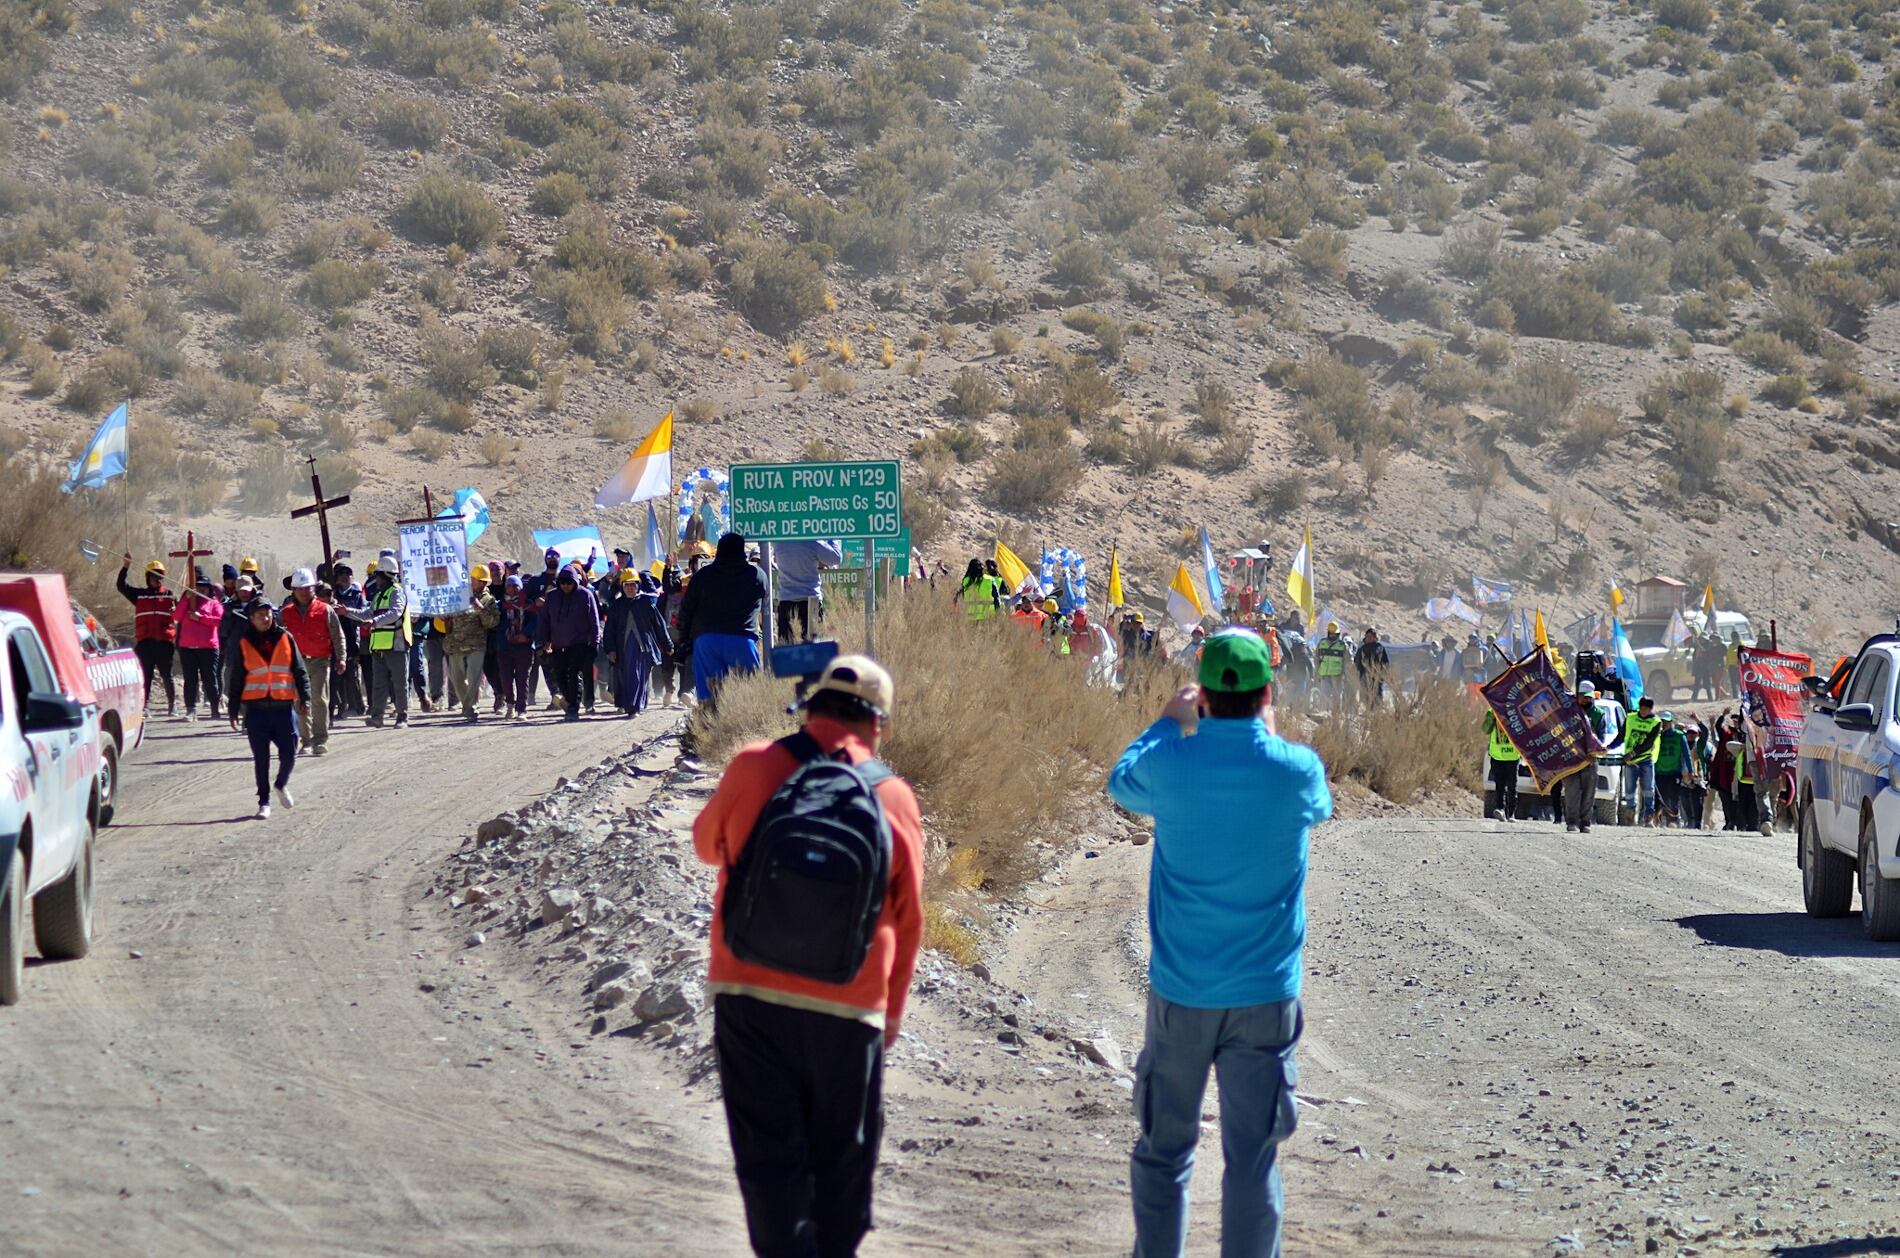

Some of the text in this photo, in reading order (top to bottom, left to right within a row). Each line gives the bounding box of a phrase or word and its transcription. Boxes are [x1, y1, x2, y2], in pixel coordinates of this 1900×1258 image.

[744, 472, 784, 489] RUTA
[792, 470, 835, 488] PROV.
[778, 502, 790, 512] DE
[790, 500, 808, 512] LOS
[875, 491, 897, 510] 50
[433, 523, 464, 532] VIRGEN
[735, 513, 897, 536] SALAR DE POCITOS 105
[423, 538, 441, 547] DEL
[410, 546, 455, 557] MILAGRO
[446, 555, 457, 564] DE
[1741, 652, 1809, 672] Peregrinos
